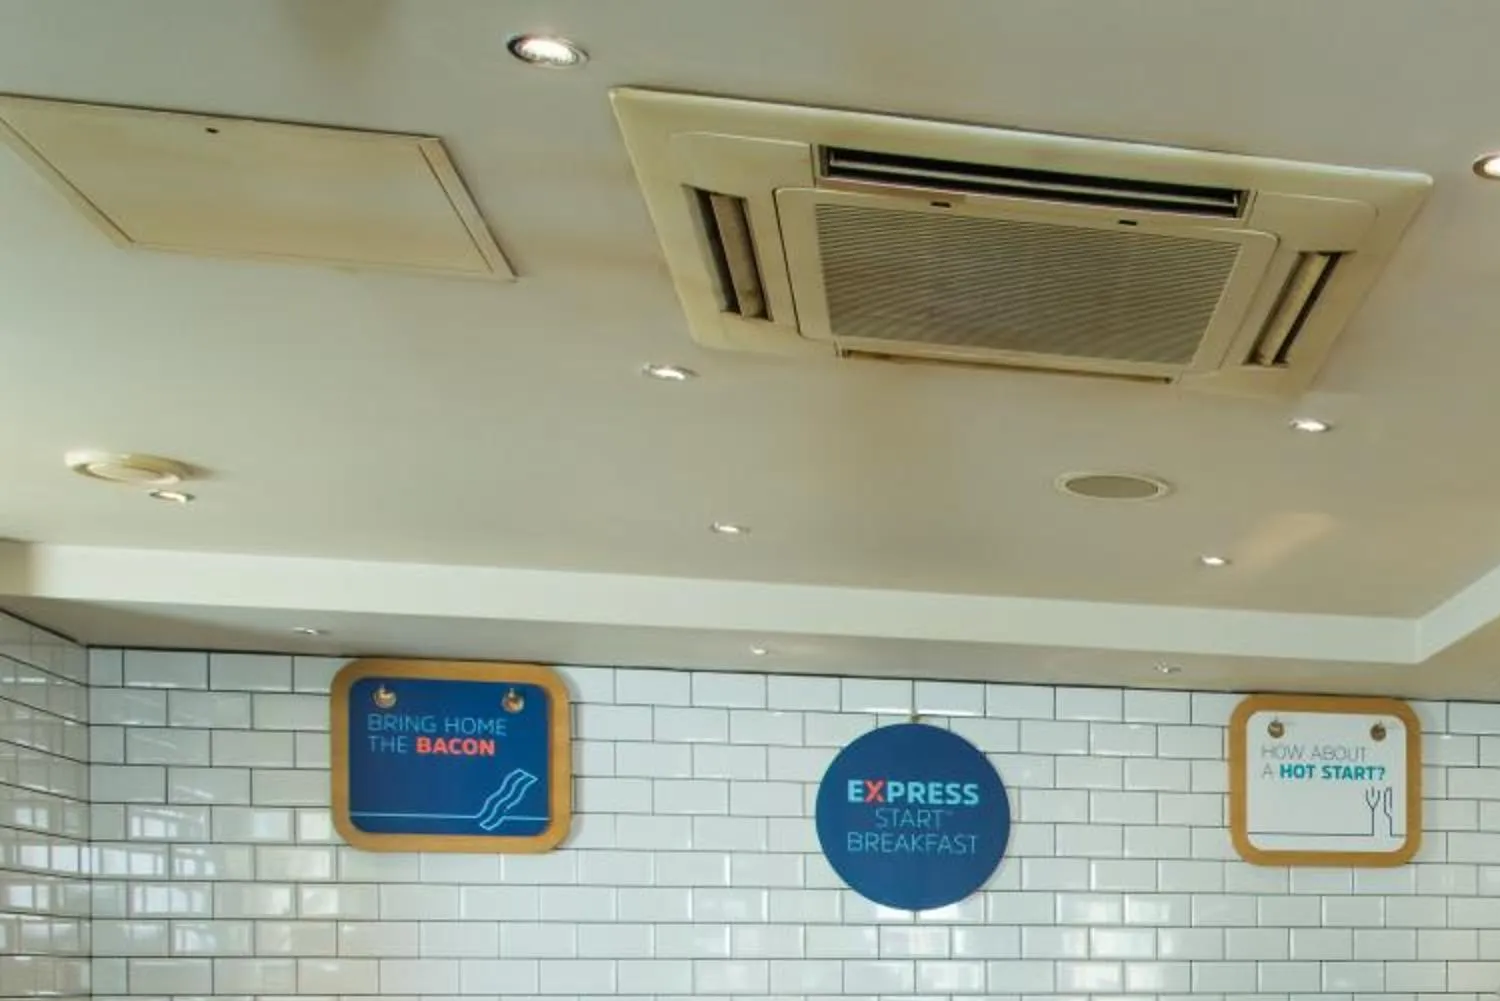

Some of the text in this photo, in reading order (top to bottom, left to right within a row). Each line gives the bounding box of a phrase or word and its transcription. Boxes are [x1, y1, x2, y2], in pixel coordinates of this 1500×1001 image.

[367, 713, 508, 737] BRING HOME
[368, 735, 496, 756] THE BACON
[1261, 744, 1366, 763] HOW ABOUT
[1261, 763, 1386, 781] A HOT START?
[847, 779, 979, 805] EXPRESS
[847, 831, 978, 854] BREAKFAST
